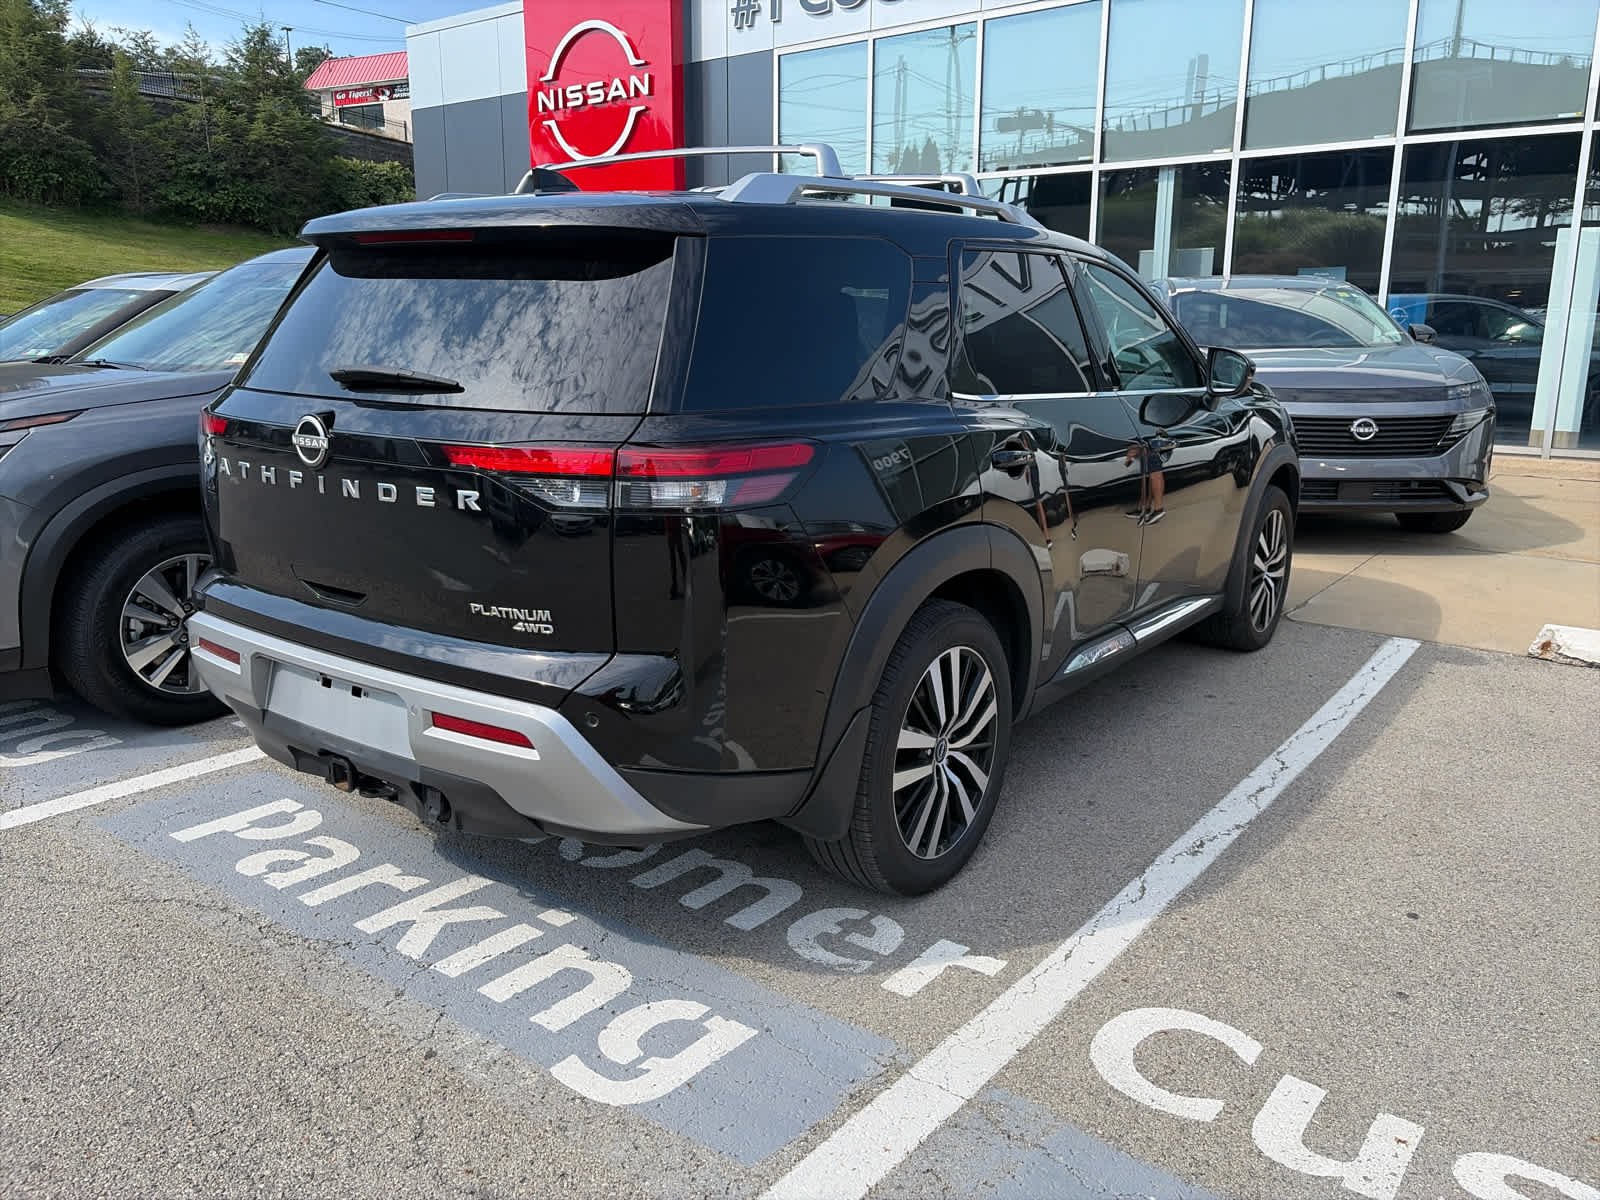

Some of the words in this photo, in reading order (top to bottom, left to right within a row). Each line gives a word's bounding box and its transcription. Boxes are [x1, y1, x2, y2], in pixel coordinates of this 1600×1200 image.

[537, 73, 650, 113] NISSAN
[470, 602, 553, 622] PLATINUM
[512, 621, 554, 634] 4WD
[171, 798, 757, 1106] Parking
